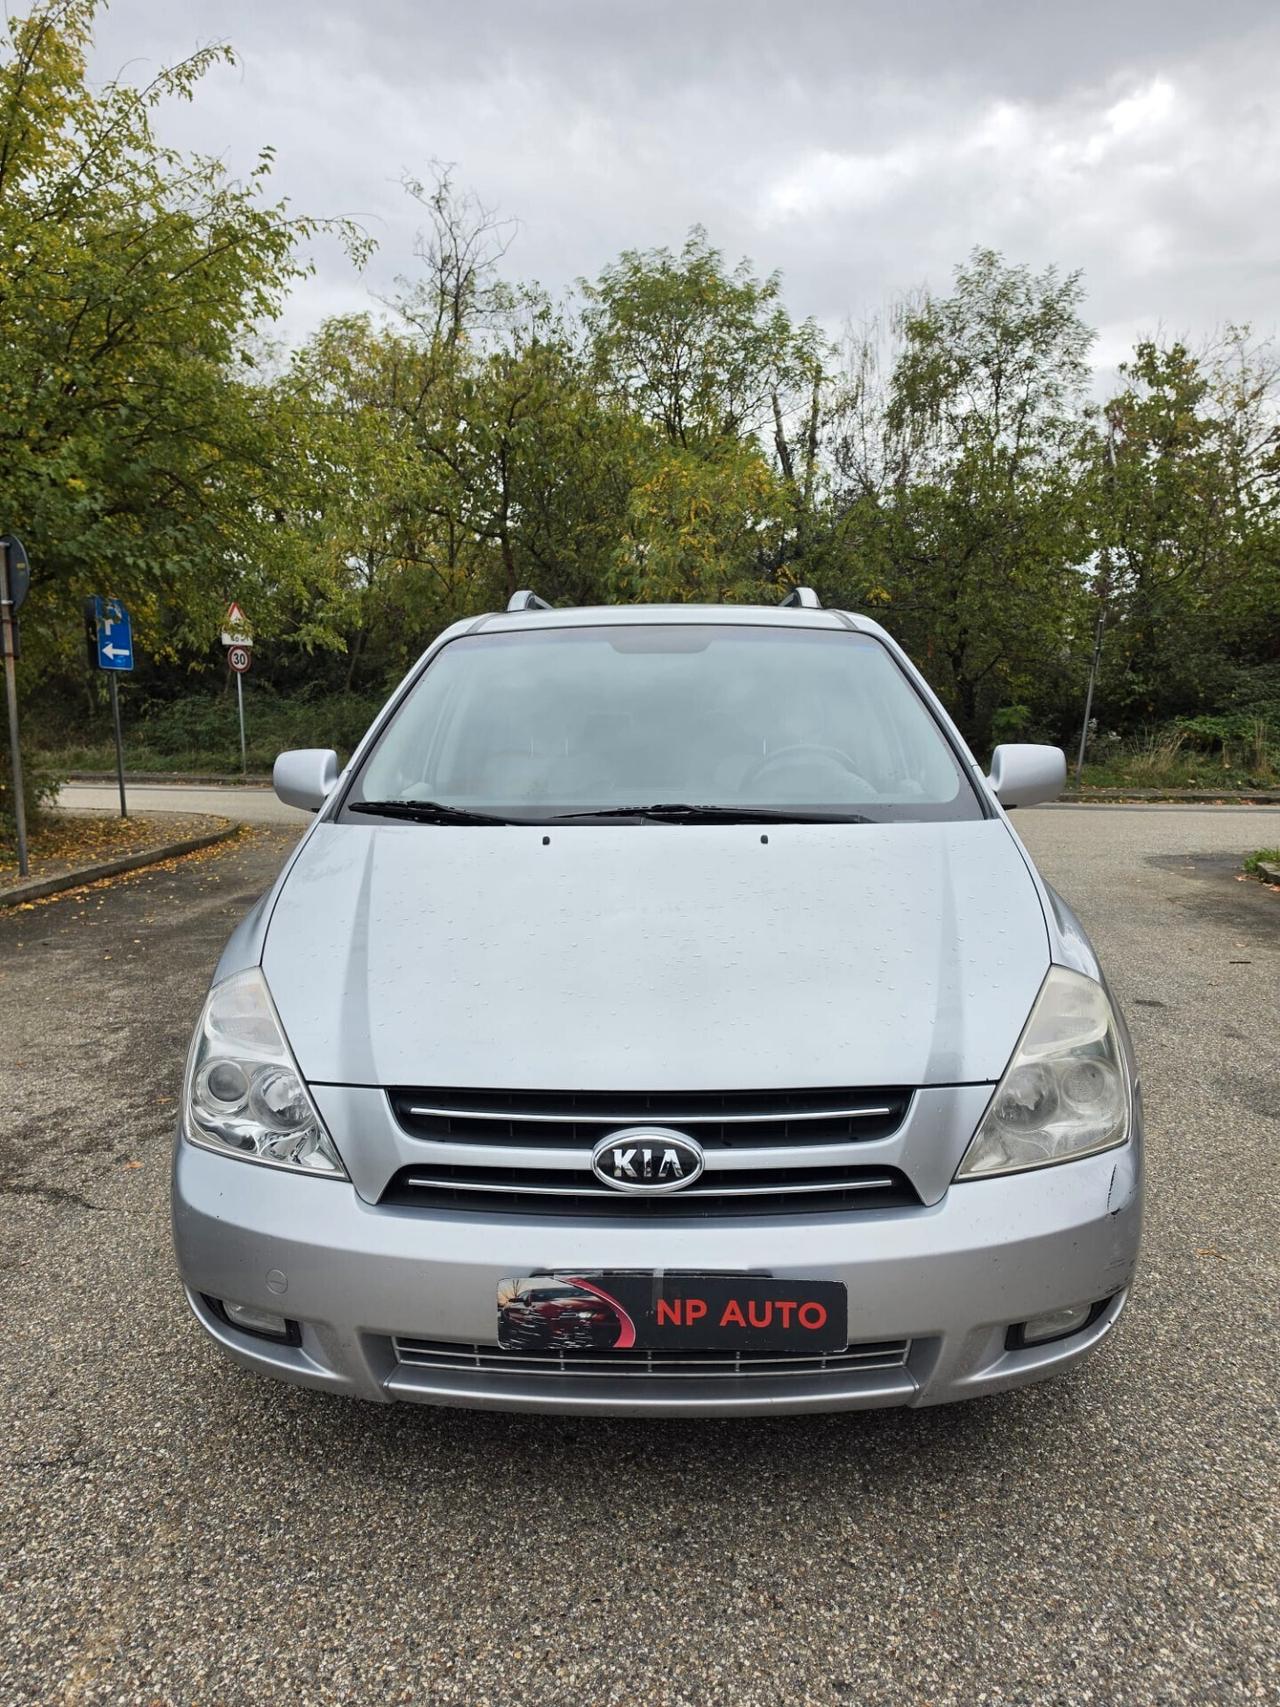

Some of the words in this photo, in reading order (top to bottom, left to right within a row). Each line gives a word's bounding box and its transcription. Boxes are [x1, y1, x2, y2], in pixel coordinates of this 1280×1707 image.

[233, 653, 246, 665] 30
[612, 1149, 684, 1177] KIA
[657, 1299, 707, 1326] NP
[719, 1300, 828, 1330] AUTO
